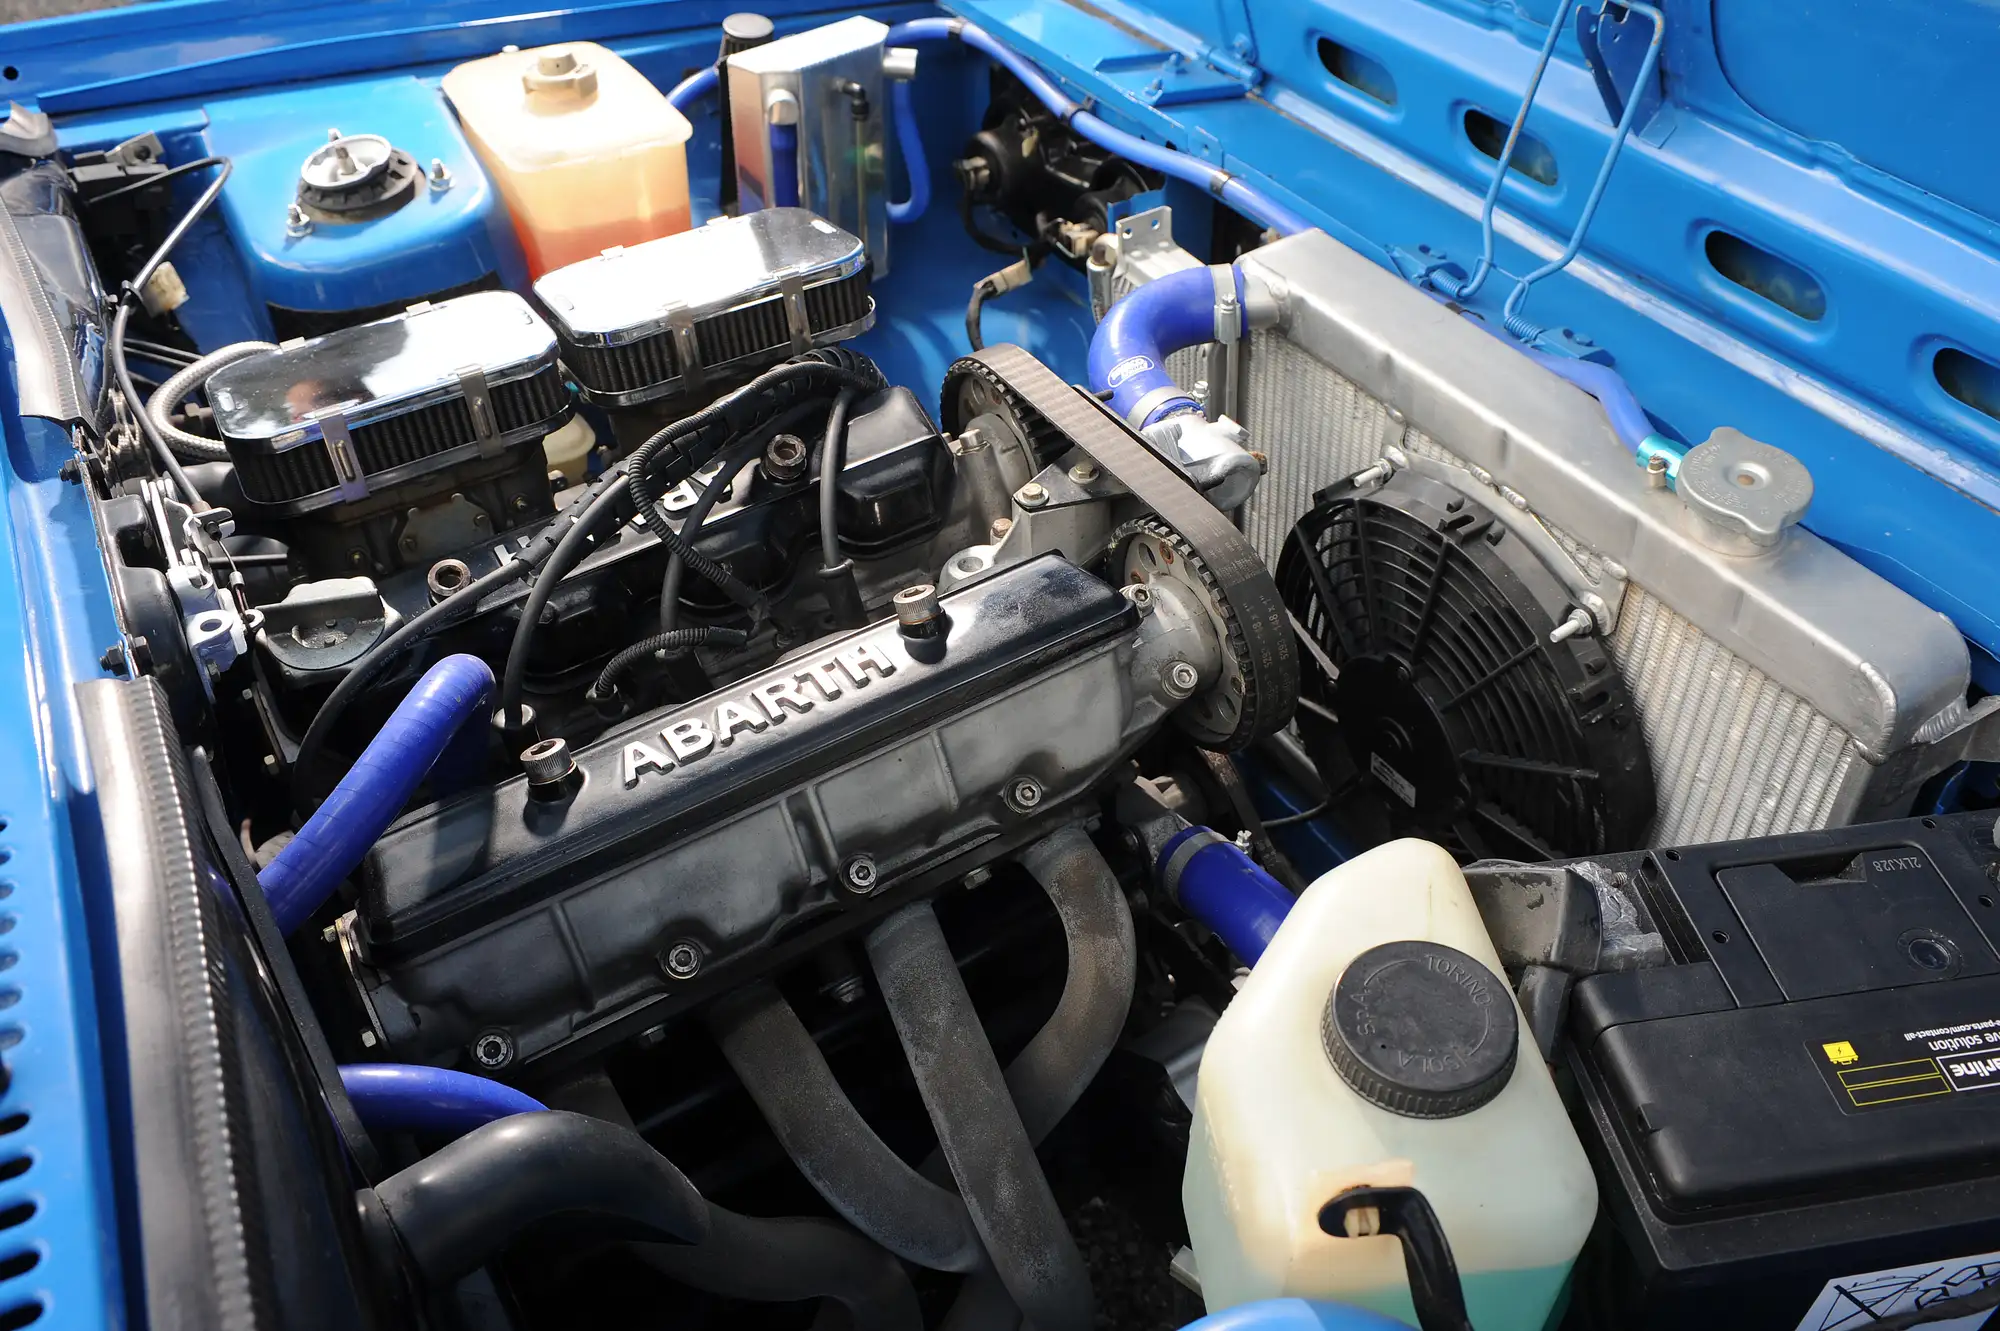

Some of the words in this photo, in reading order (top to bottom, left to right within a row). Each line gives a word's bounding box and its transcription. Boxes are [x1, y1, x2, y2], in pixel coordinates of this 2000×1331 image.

[623, 643, 897, 790] ABARTH
[1872, 857, 1922, 872] 2LKJ28
[1425, 953, 1493, 1007] TORINO
[1928, 1034, 1983, 1052] solution
